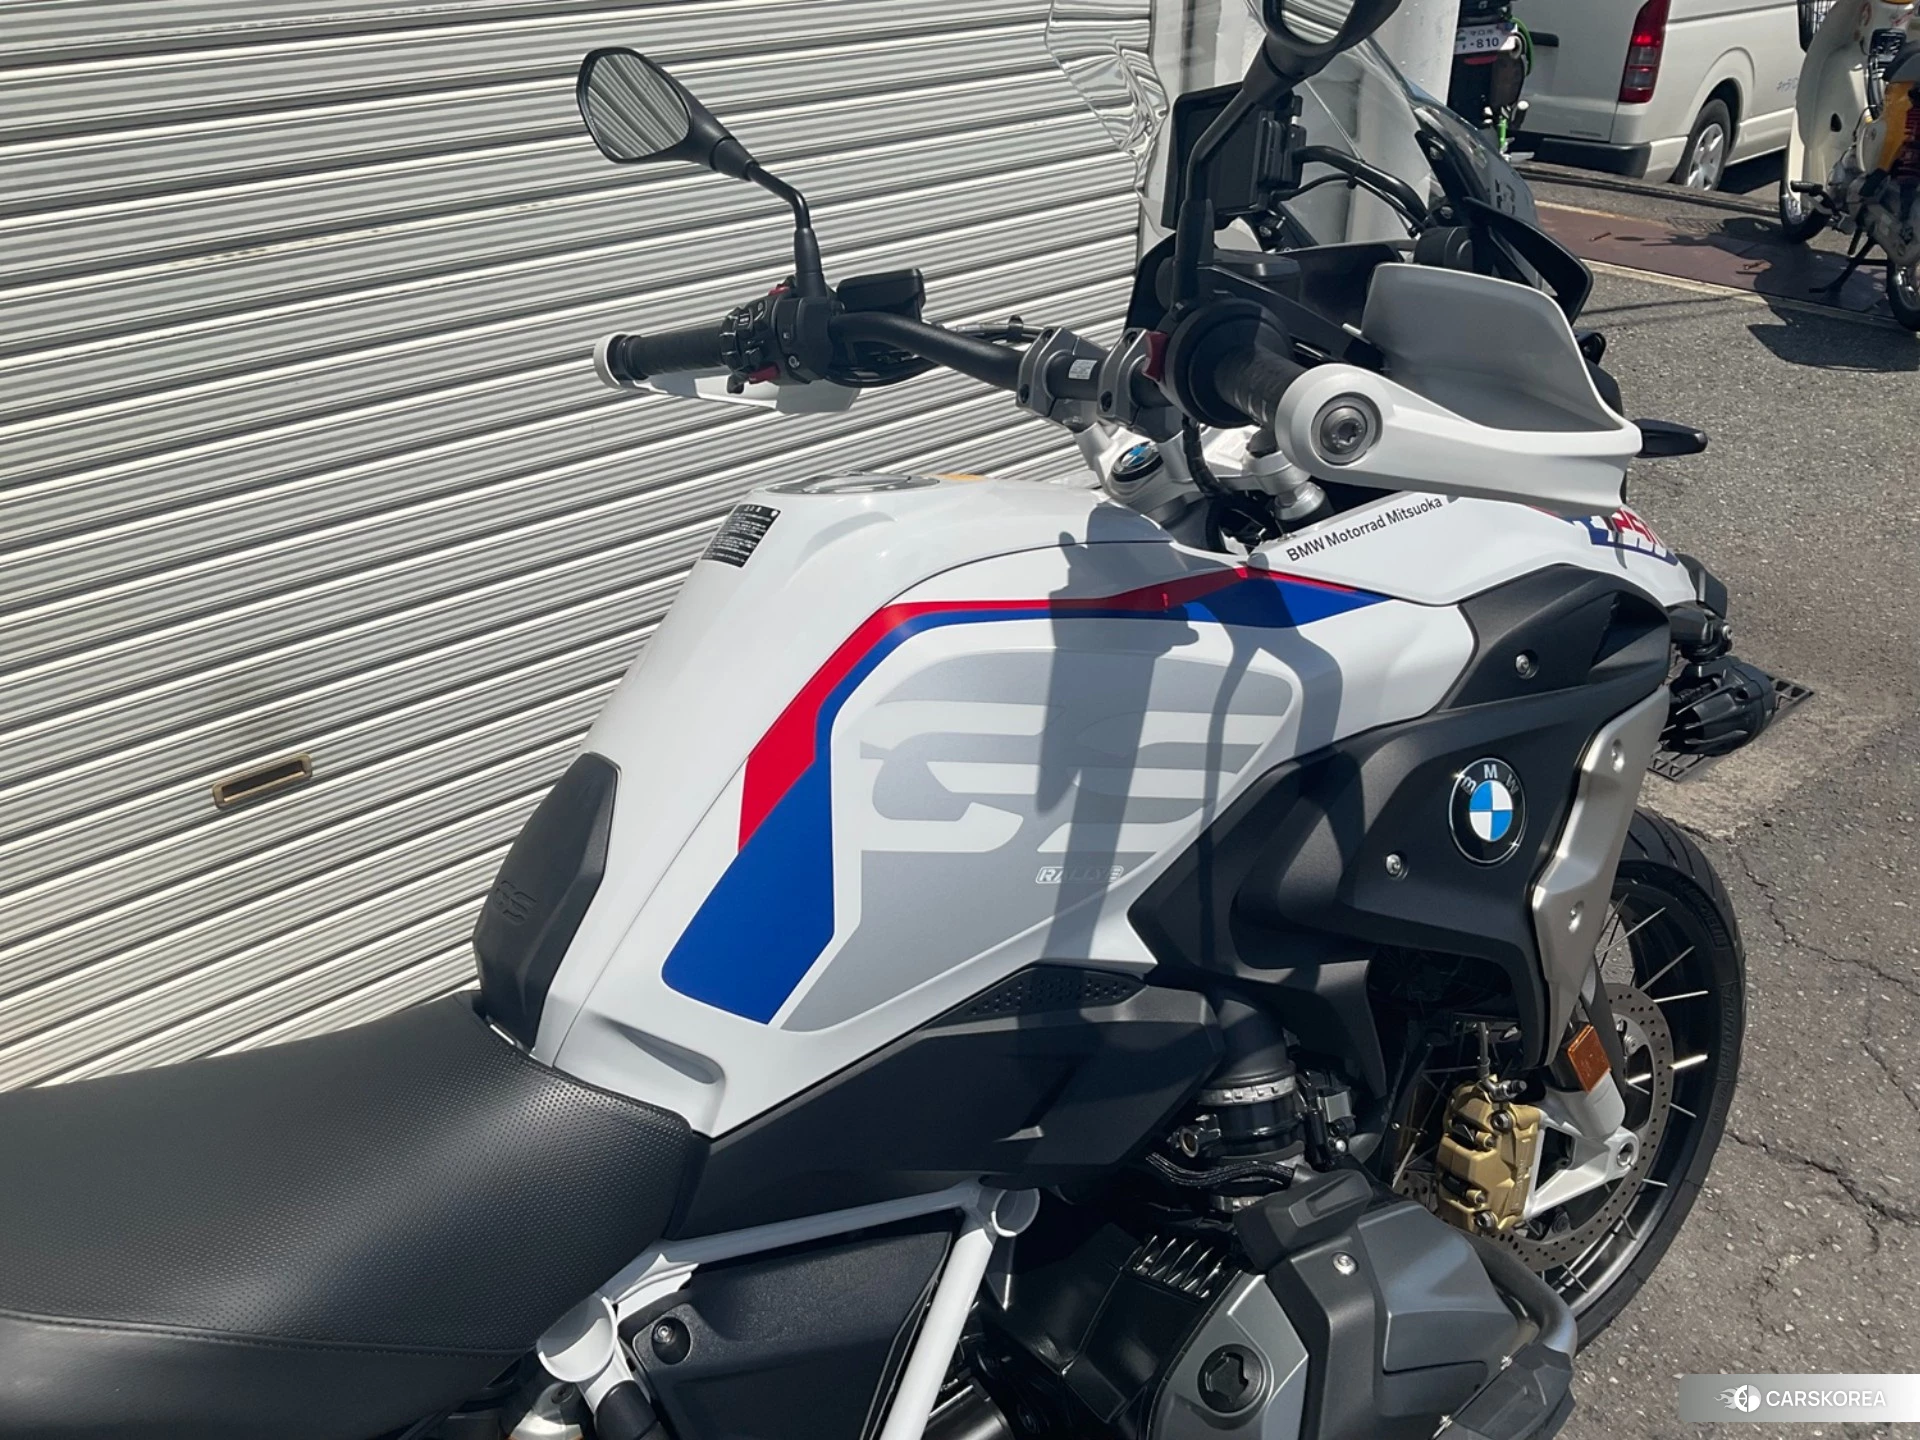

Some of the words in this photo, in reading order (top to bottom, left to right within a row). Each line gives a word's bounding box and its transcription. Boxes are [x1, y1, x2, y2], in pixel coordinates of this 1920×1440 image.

[1286, 537, 1326, 562] BMW
[1325, 515, 1387, 547] Motorrad
[1385, 496, 1443, 525] Mitsuoka
[1461, 763, 1519, 796] BMW
